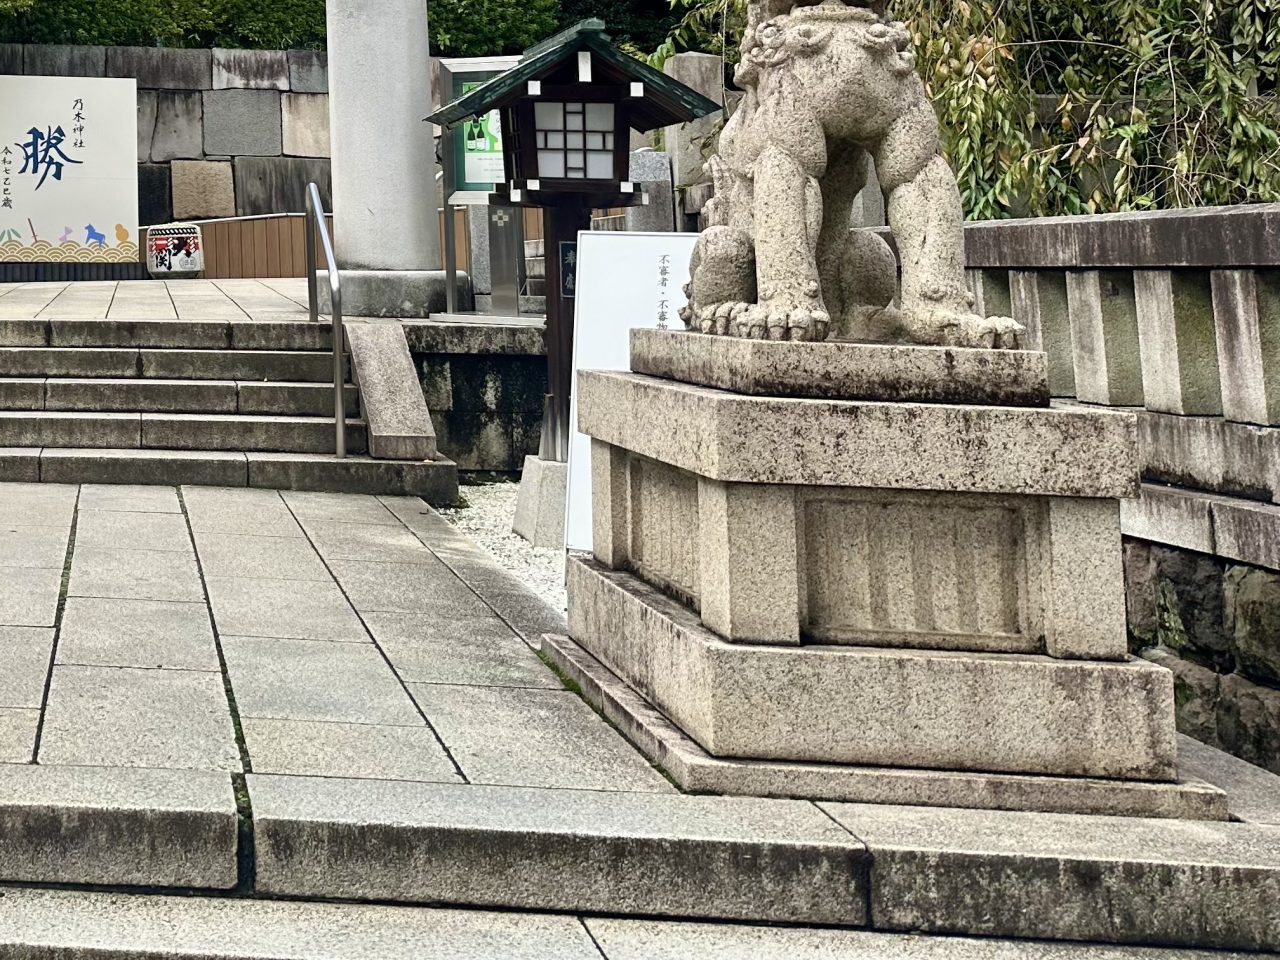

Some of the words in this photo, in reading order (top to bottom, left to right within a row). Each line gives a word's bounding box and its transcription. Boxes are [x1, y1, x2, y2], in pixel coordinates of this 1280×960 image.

[72, 98, 86, 148] 乃木神社
[14, 125, 84, 191] 勝
